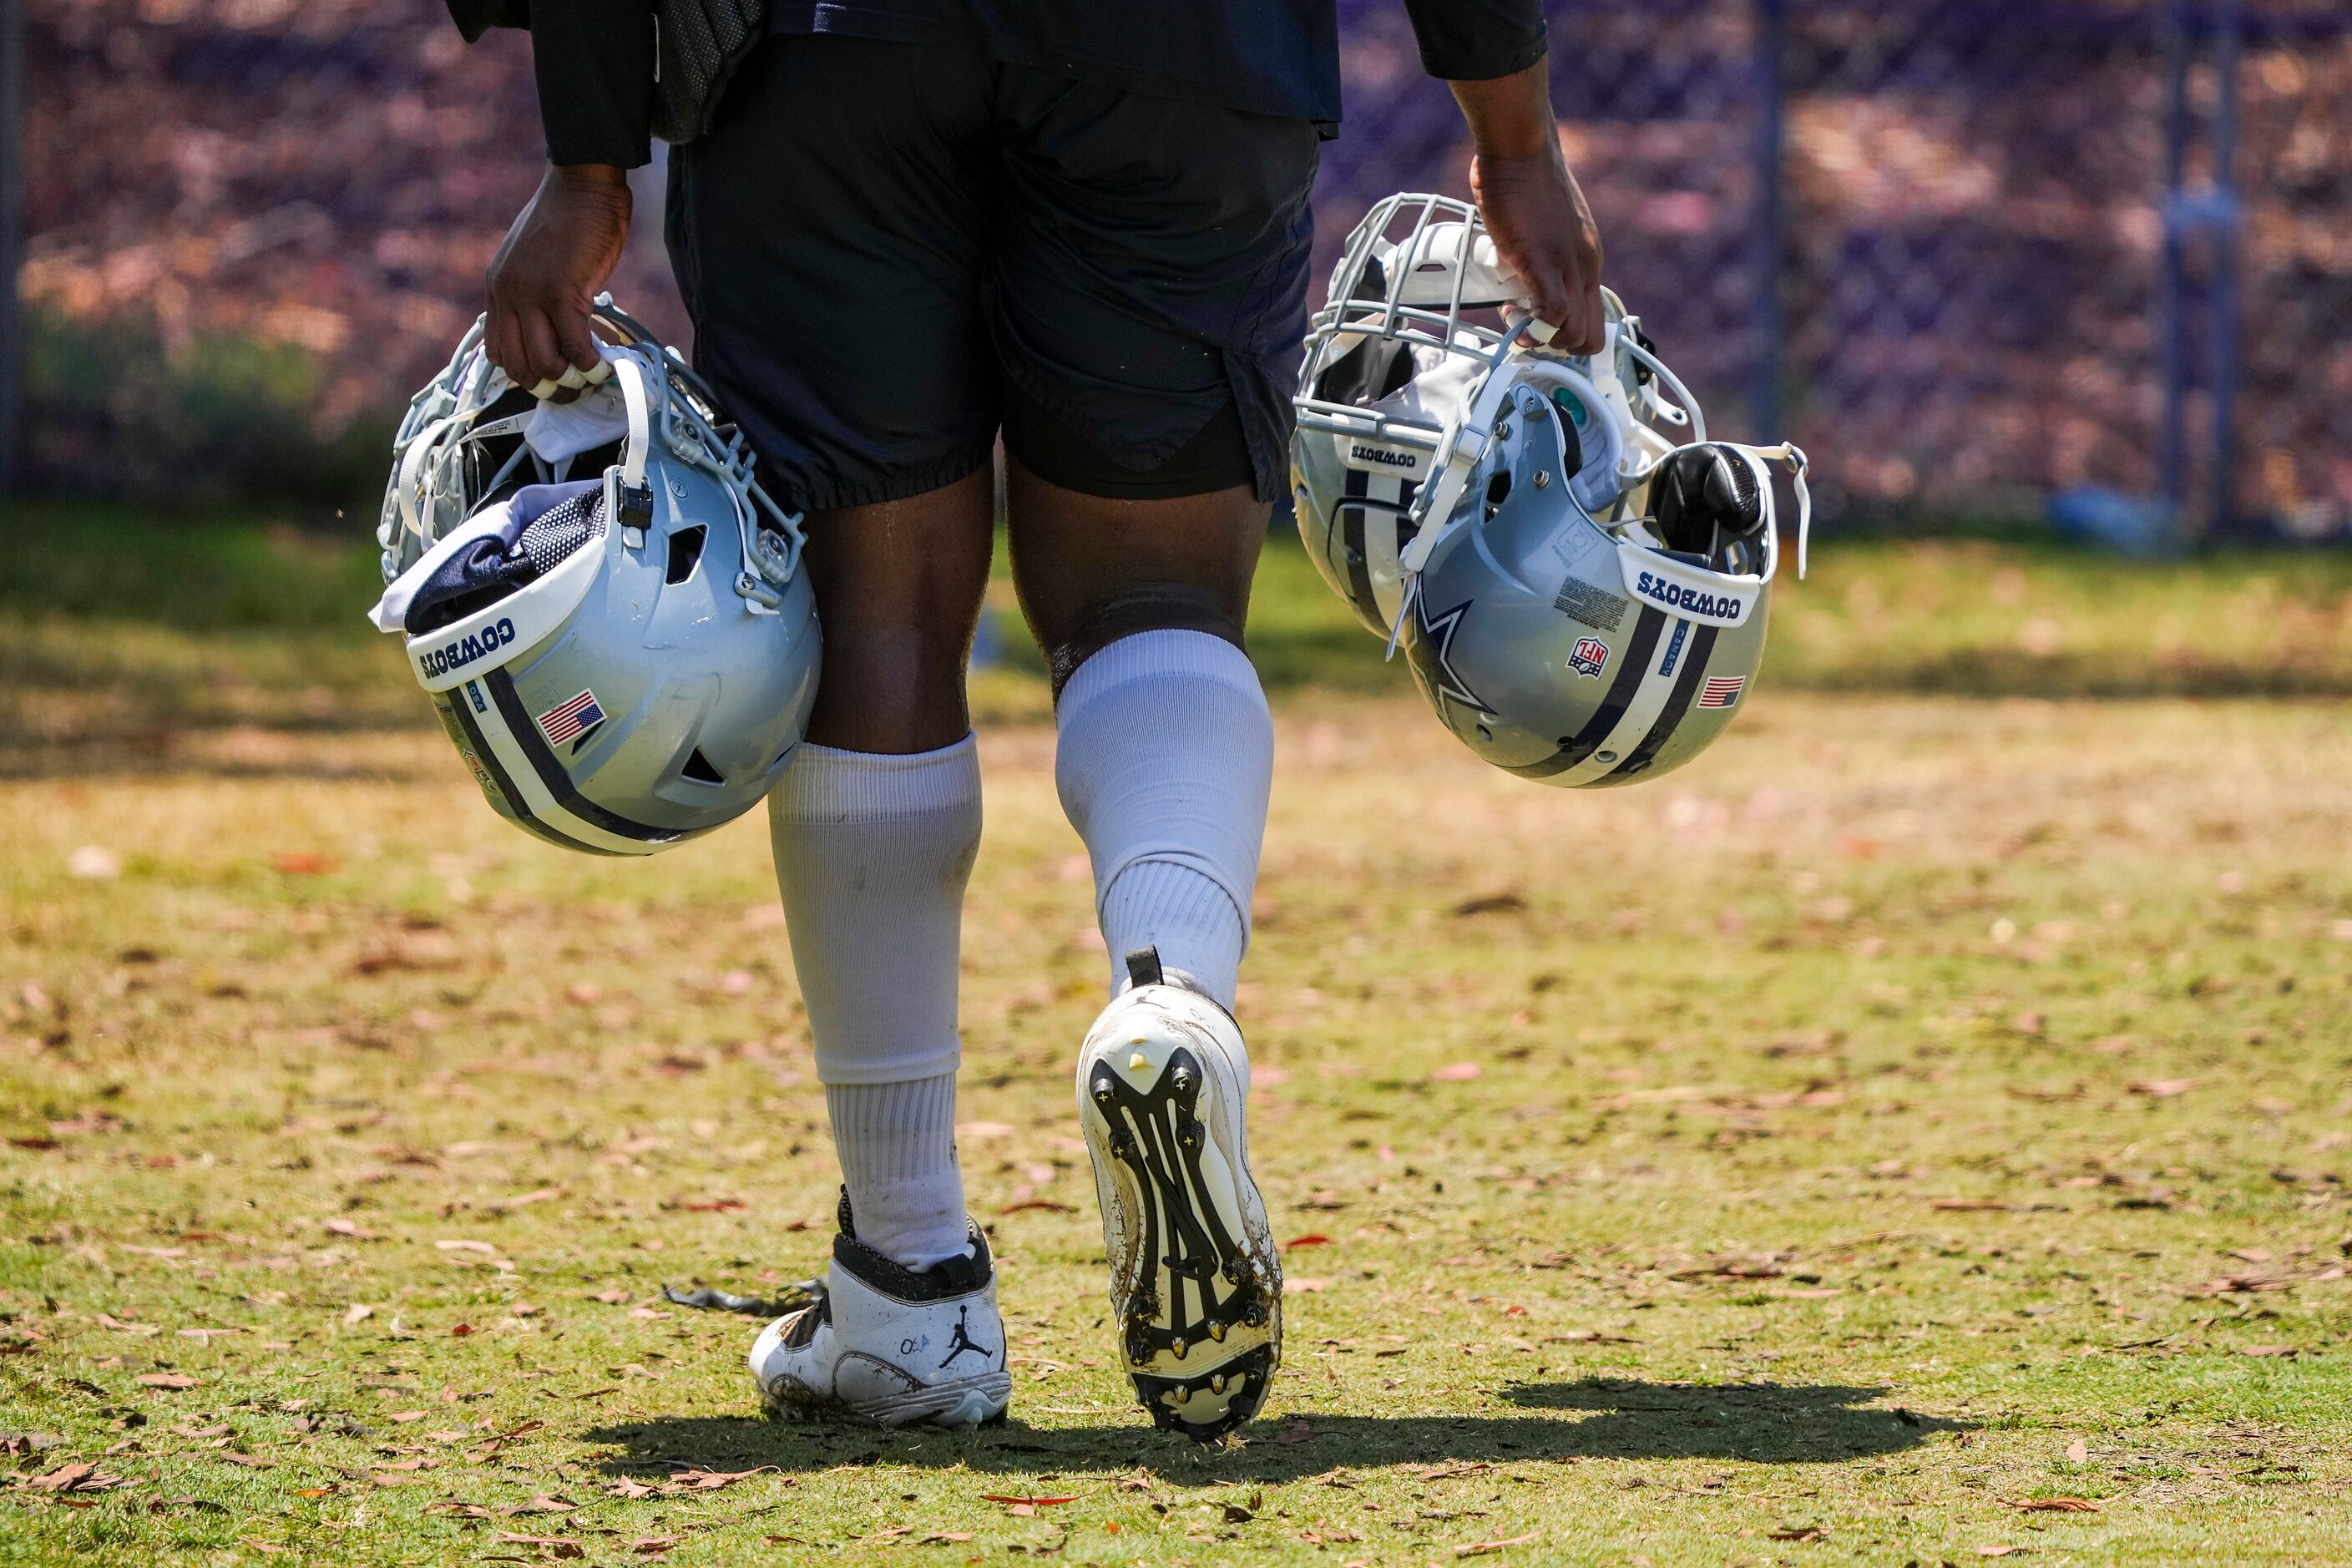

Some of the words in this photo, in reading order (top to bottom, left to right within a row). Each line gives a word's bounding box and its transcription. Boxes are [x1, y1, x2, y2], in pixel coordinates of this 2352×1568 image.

[1352, 445, 1416, 468] COWBOYS
[1637, 571, 1741, 620] COWBOYS
[1567, 613, 1599, 630] WARNING
[420, 618, 516, 680] COWBOYS
[1579, 641, 1606, 665] NFL
[1662, 629, 1685, 676] CANADY
[469, 686, 483, 711] OSA
